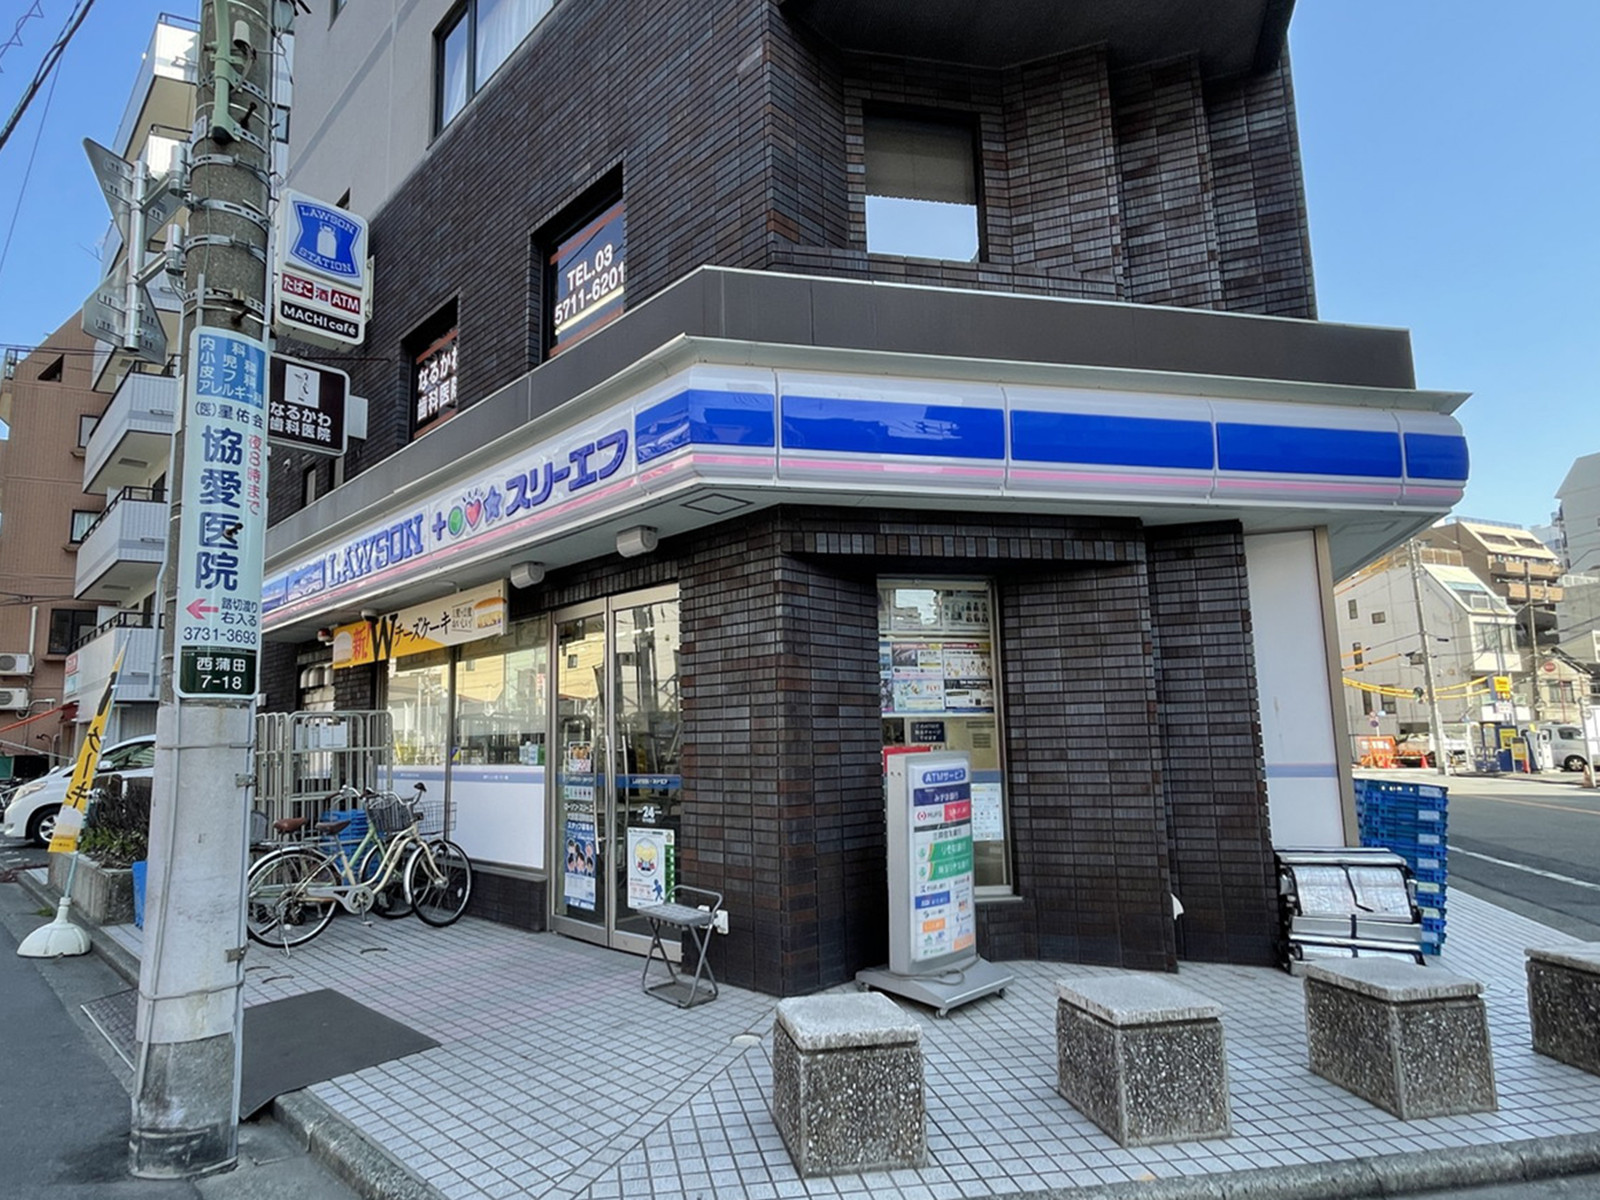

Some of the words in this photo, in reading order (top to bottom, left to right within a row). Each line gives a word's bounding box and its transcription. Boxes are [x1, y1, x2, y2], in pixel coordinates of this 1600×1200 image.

[300, 206, 356, 235] LAWSON
[297, 246, 353, 273] STATION
[567, 243, 613, 291] TEL.03
[283, 275, 313, 298] たばこ
[332, 294, 360, 312] ATM
[554, 261, 625, 325] 5711-6201
[283, 305, 327, 328] MACHI
[328, 317, 357, 336] café
[199, 351, 258, 376] 小児科
[199, 365, 257, 389] 皮フ科
[198, 380, 264, 407] アレルギー科
[270, 401, 332, 427] なるかわ
[269, 416, 332, 442] 歯科医院
[246, 435, 263, 516] 夜8時まで
[505, 428, 629, 517] スリーエフ
[195, 425, 243, 591] 協愛医院
[326, 513, 424, 588] LAWSON
[221, 597, 258, 614] 踏切渡り
[221, 611, 257, 627] 右入る
[183, 626, 257, 645] 3731-3693
[196, 656, 246, 672] 西蒲田
[201, 675, 242, 690] 7-18
[642, 805, 655, 818] 24
